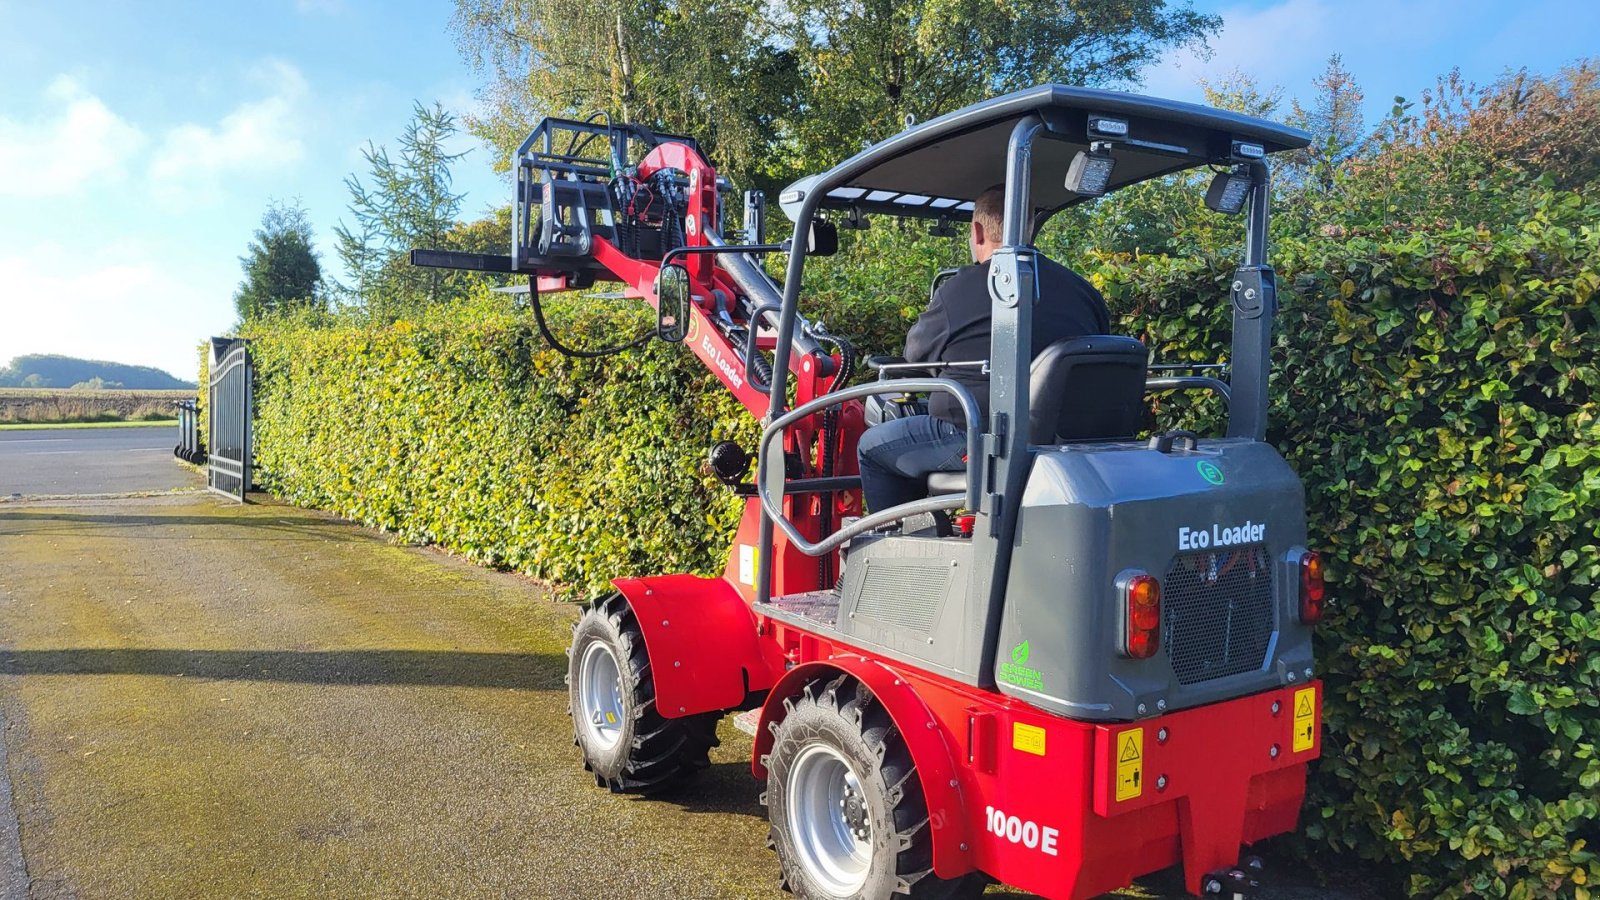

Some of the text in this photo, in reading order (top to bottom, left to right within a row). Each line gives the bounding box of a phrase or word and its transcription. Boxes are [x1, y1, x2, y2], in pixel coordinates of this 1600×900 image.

[702, 334, 743, 389] Eco Loader
[1178, 520, 1265, 550] Eco Loader
[1001, 662, 1041, 681] GREEN
[985, 805, 1059, 856] 1000 E
